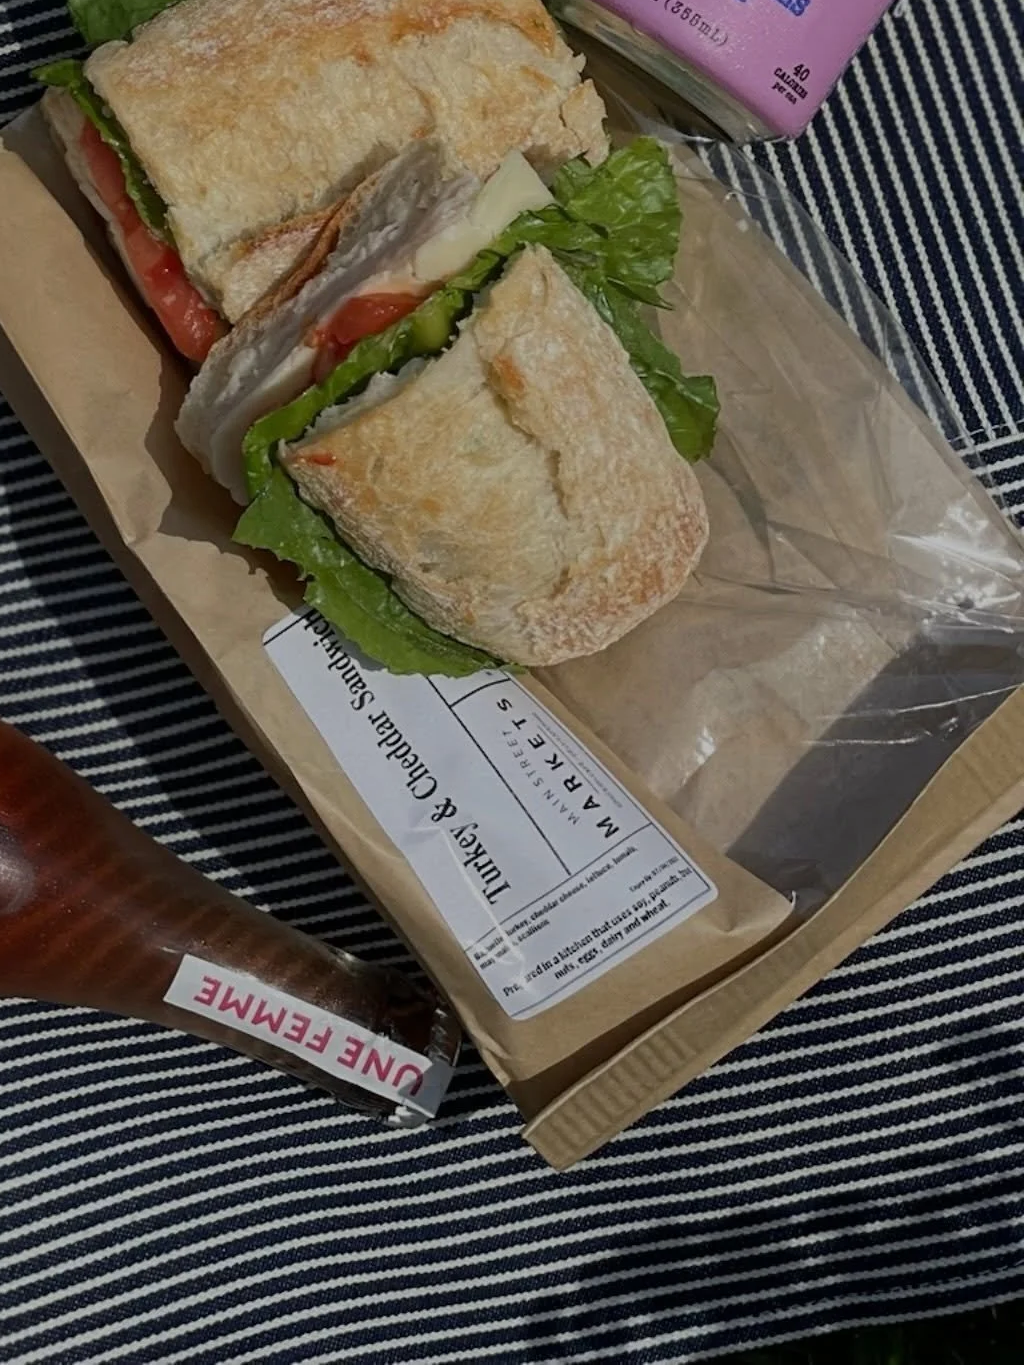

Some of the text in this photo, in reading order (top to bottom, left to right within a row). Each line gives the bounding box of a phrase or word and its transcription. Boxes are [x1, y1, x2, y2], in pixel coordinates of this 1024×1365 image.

[773, 66, 808, 99] CALORIES
[790, 61, 812, 82] 40
[359, 705, 441, 804] Cheddar
[495, 697, 619, 839] MARKETS
[501, 731, 544, 787] STREET
[425, 795, 459, 827] &
[542, 789, 579, 825] MAIN
[447, 821, 512, 905] Turkey
[556, 930, 594, 962] kitchen
[590, 919, 612, 939] that
[620, 916, 641, 935] and
[192, 975, 424, 1096] UNE FEMME
